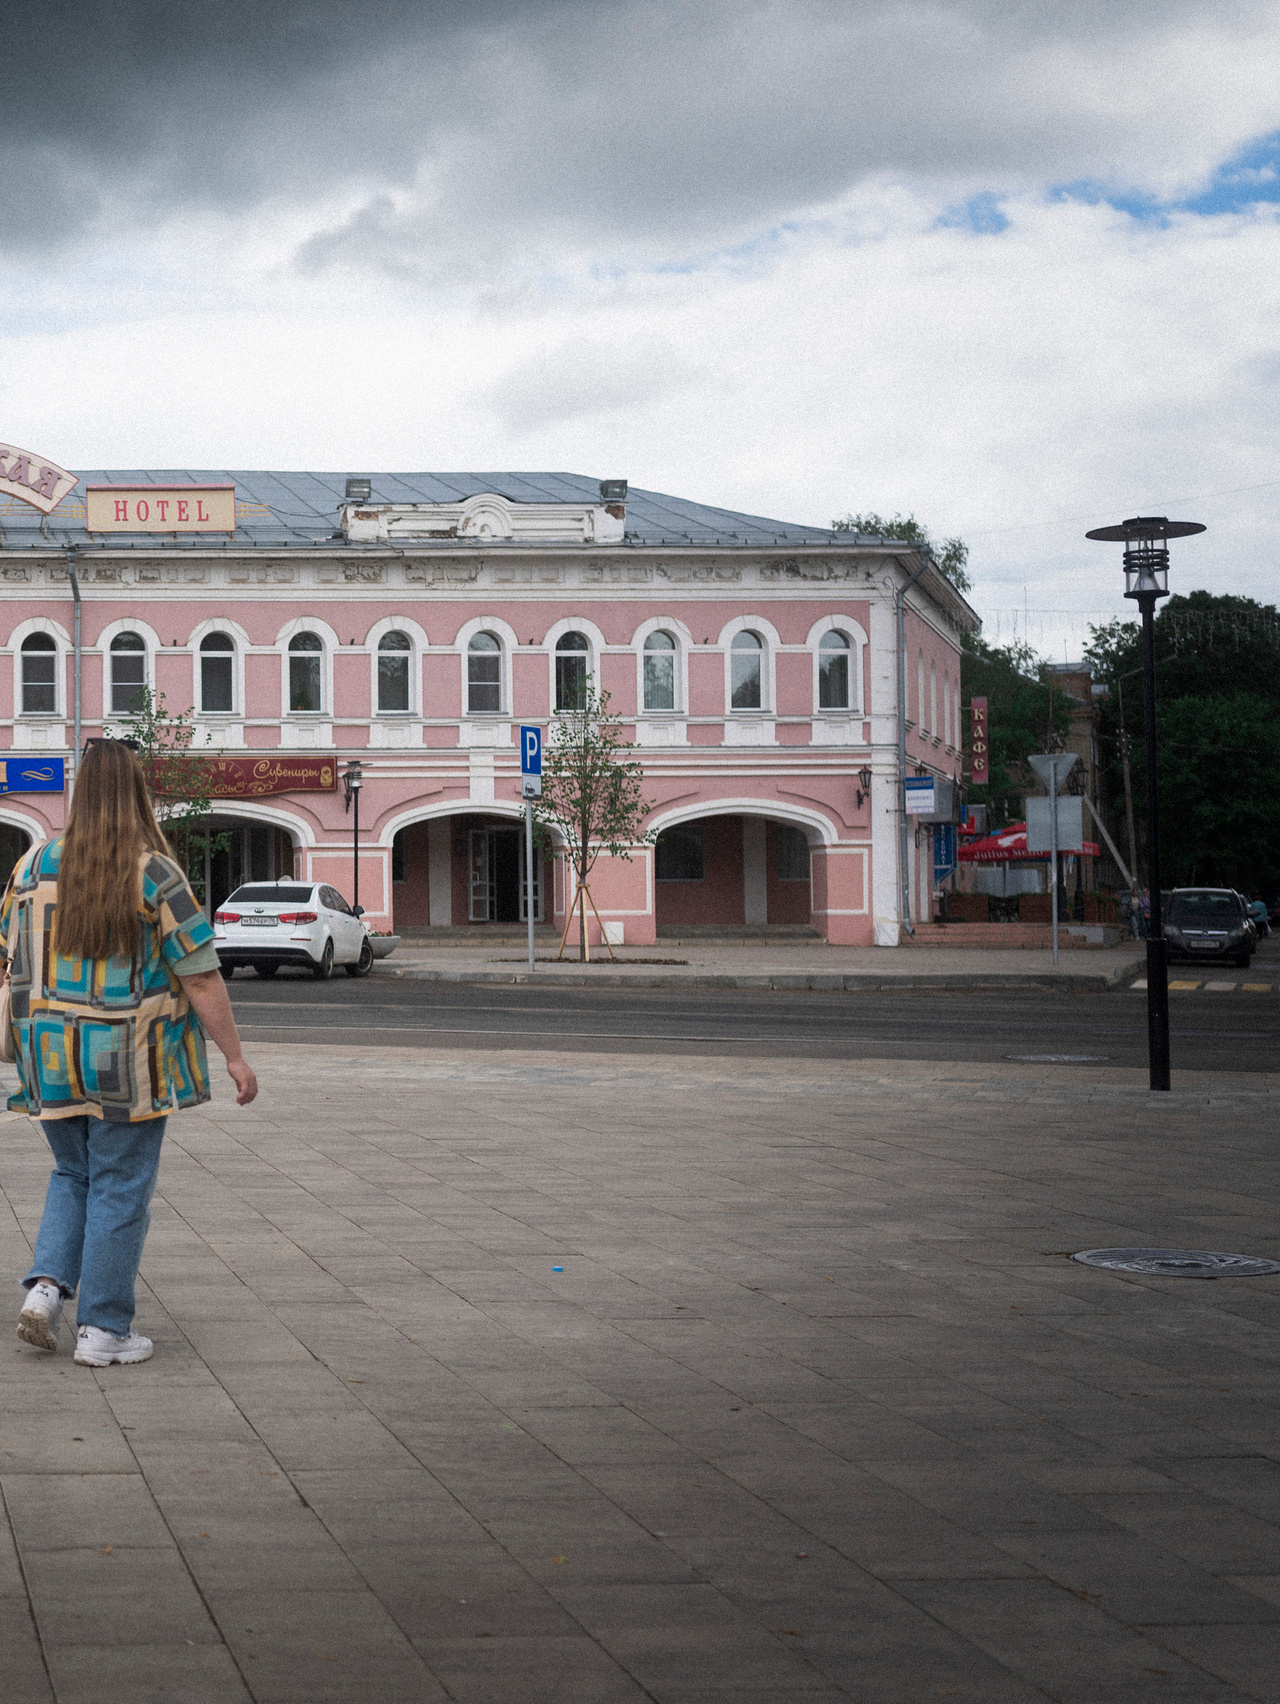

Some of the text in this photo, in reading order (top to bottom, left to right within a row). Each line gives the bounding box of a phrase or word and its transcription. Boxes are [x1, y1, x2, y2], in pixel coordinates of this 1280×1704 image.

[114, 499, 209, 521] HOTEL
[526, 731, 538, 769] P
[972, 708, 987, 771] КАФЕ
[253, 760, 320, 784] Сувениры
